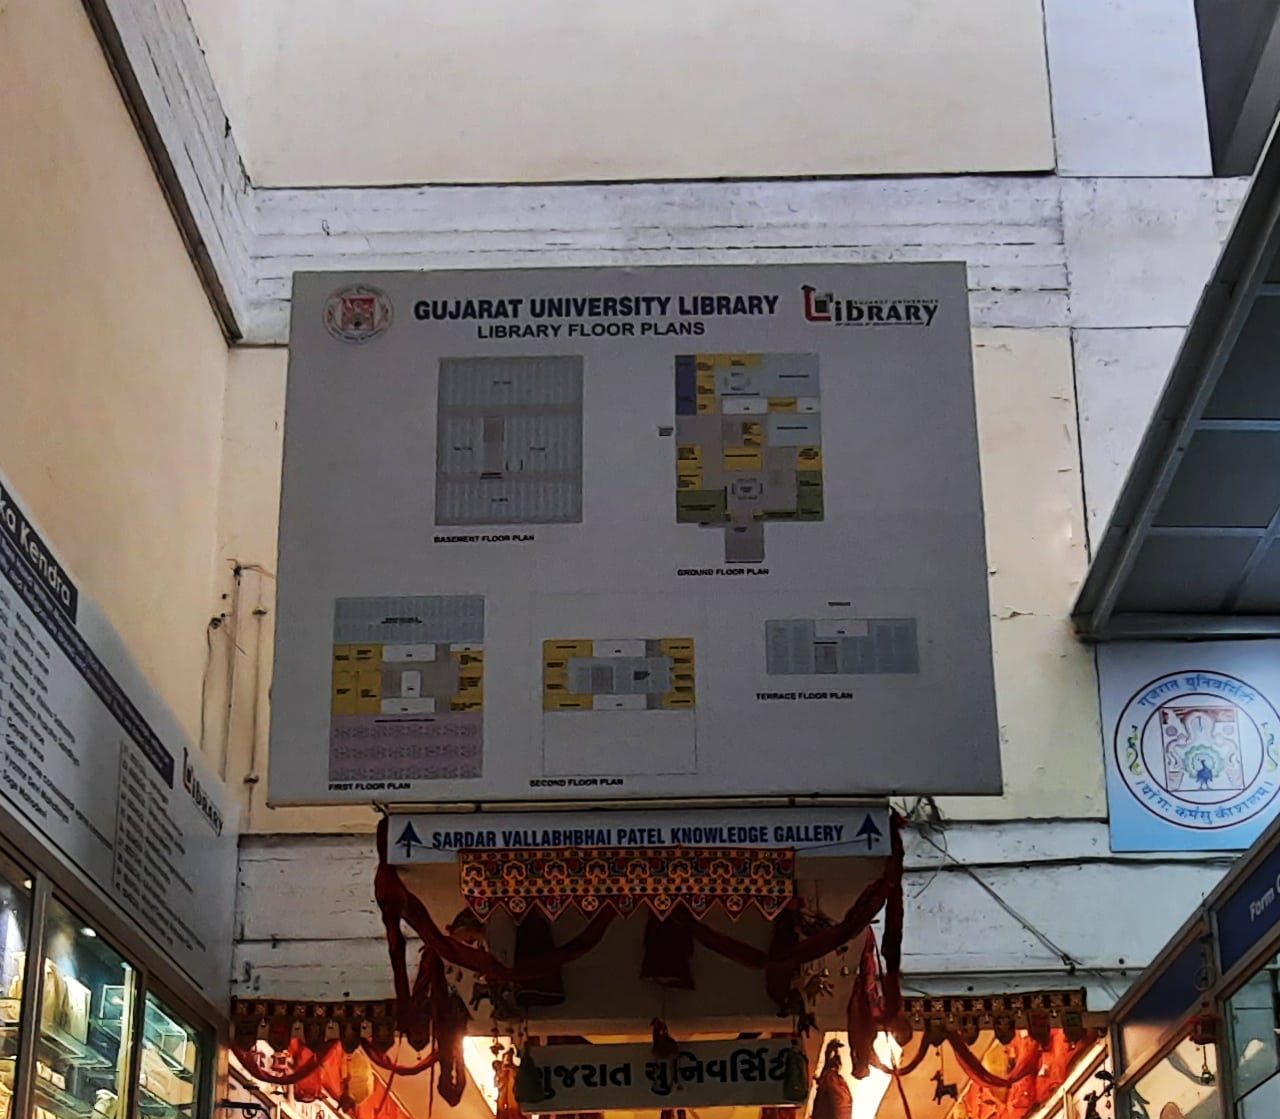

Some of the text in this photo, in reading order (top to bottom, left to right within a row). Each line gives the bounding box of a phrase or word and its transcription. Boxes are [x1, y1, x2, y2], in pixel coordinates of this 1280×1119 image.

[414, 299, 524, 322] GUJARAT
[530, 296, 672, 319] UNIVERSITY
[677, 294, 780, 316] LIBRARY
[477, 321, 705, 340] LIBRARY FLOOR PLANS
[434, 534, 534, 543] BASEMENT FLOOR PLAN
[19, 521, 70, 605] Kendra
[677, 568, 714, 576] GROUND
[716, 568, 744, 576] FLOOR
[799, 692, 829, 701] FLOOR
[831, 691, 853, 700] PLAN
[327, 781, 411, 792] FIRST FLOOR PLAN
[529, 778, 624, 788] SECOND FLOOR PLAN
[432, 824, 844, 850] SARDAR VALLABHBHAI PATEL KNOWLEDGE GALLERY
[1249, 888, 1274, 922] Form
